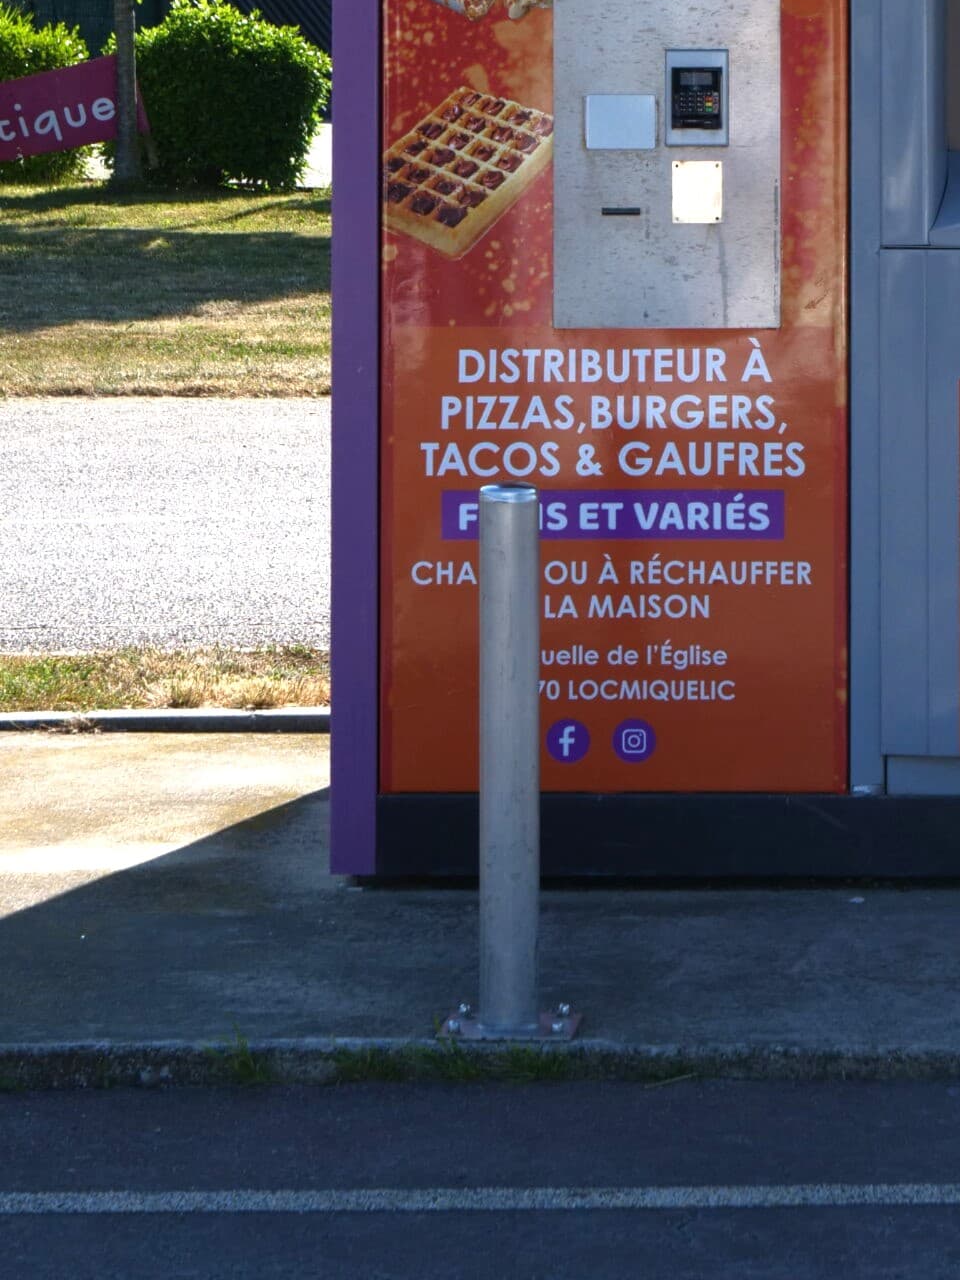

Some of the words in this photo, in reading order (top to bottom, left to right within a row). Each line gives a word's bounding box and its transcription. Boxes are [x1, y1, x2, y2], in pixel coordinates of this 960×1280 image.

[0, 97, 116, 141] tique
[458, 348, 726, 383] DISTRIBUTEUR
[740, 337, 773, 382] À
[420, 442, 560, 476] TACOS
[575, 442, 604, 476] &
[617, 441, 806, 476] GAUFRES
[579, 502, 623, 530] ET
[633, 493, 770, 530] VARIÉS
[410, 560, 478, 586] CHA
[544, 560, 588, 585] OU
[597, 554, 619, 585] À
[630, 554, 812, 586] RÉCHAUFFER
[544, 594, 578, 619] LA
[587, 594, 710, 619] MAISON
[541, 645, 599, 665] uelle
[607, 644, 639, 665] de
[568, 679, 736, 702] LOCMIQUELIC
